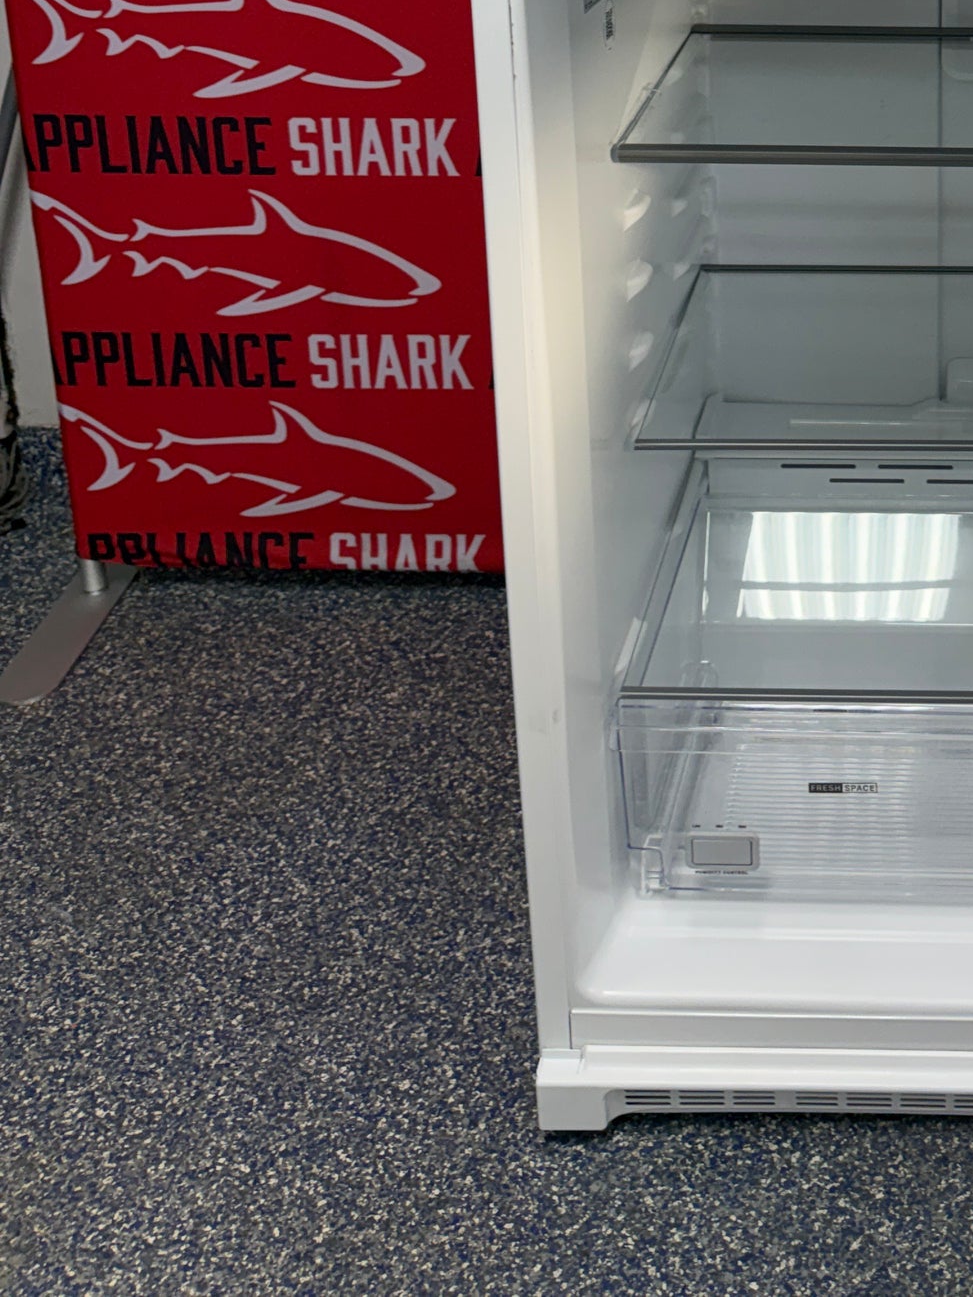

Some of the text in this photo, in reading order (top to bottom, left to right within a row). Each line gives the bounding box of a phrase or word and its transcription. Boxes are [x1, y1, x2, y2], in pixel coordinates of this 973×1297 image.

[22, 114, 276, 174] PPLIANCE
[289, 118, 458, 176] SHARK
[51, 331, 296, 388] PPLIANCE
[309, 335, 471, 389] SHARK
[330, 532, 486, 571] SHARK
[810, 784, 875, 792] FRESH SPACE
